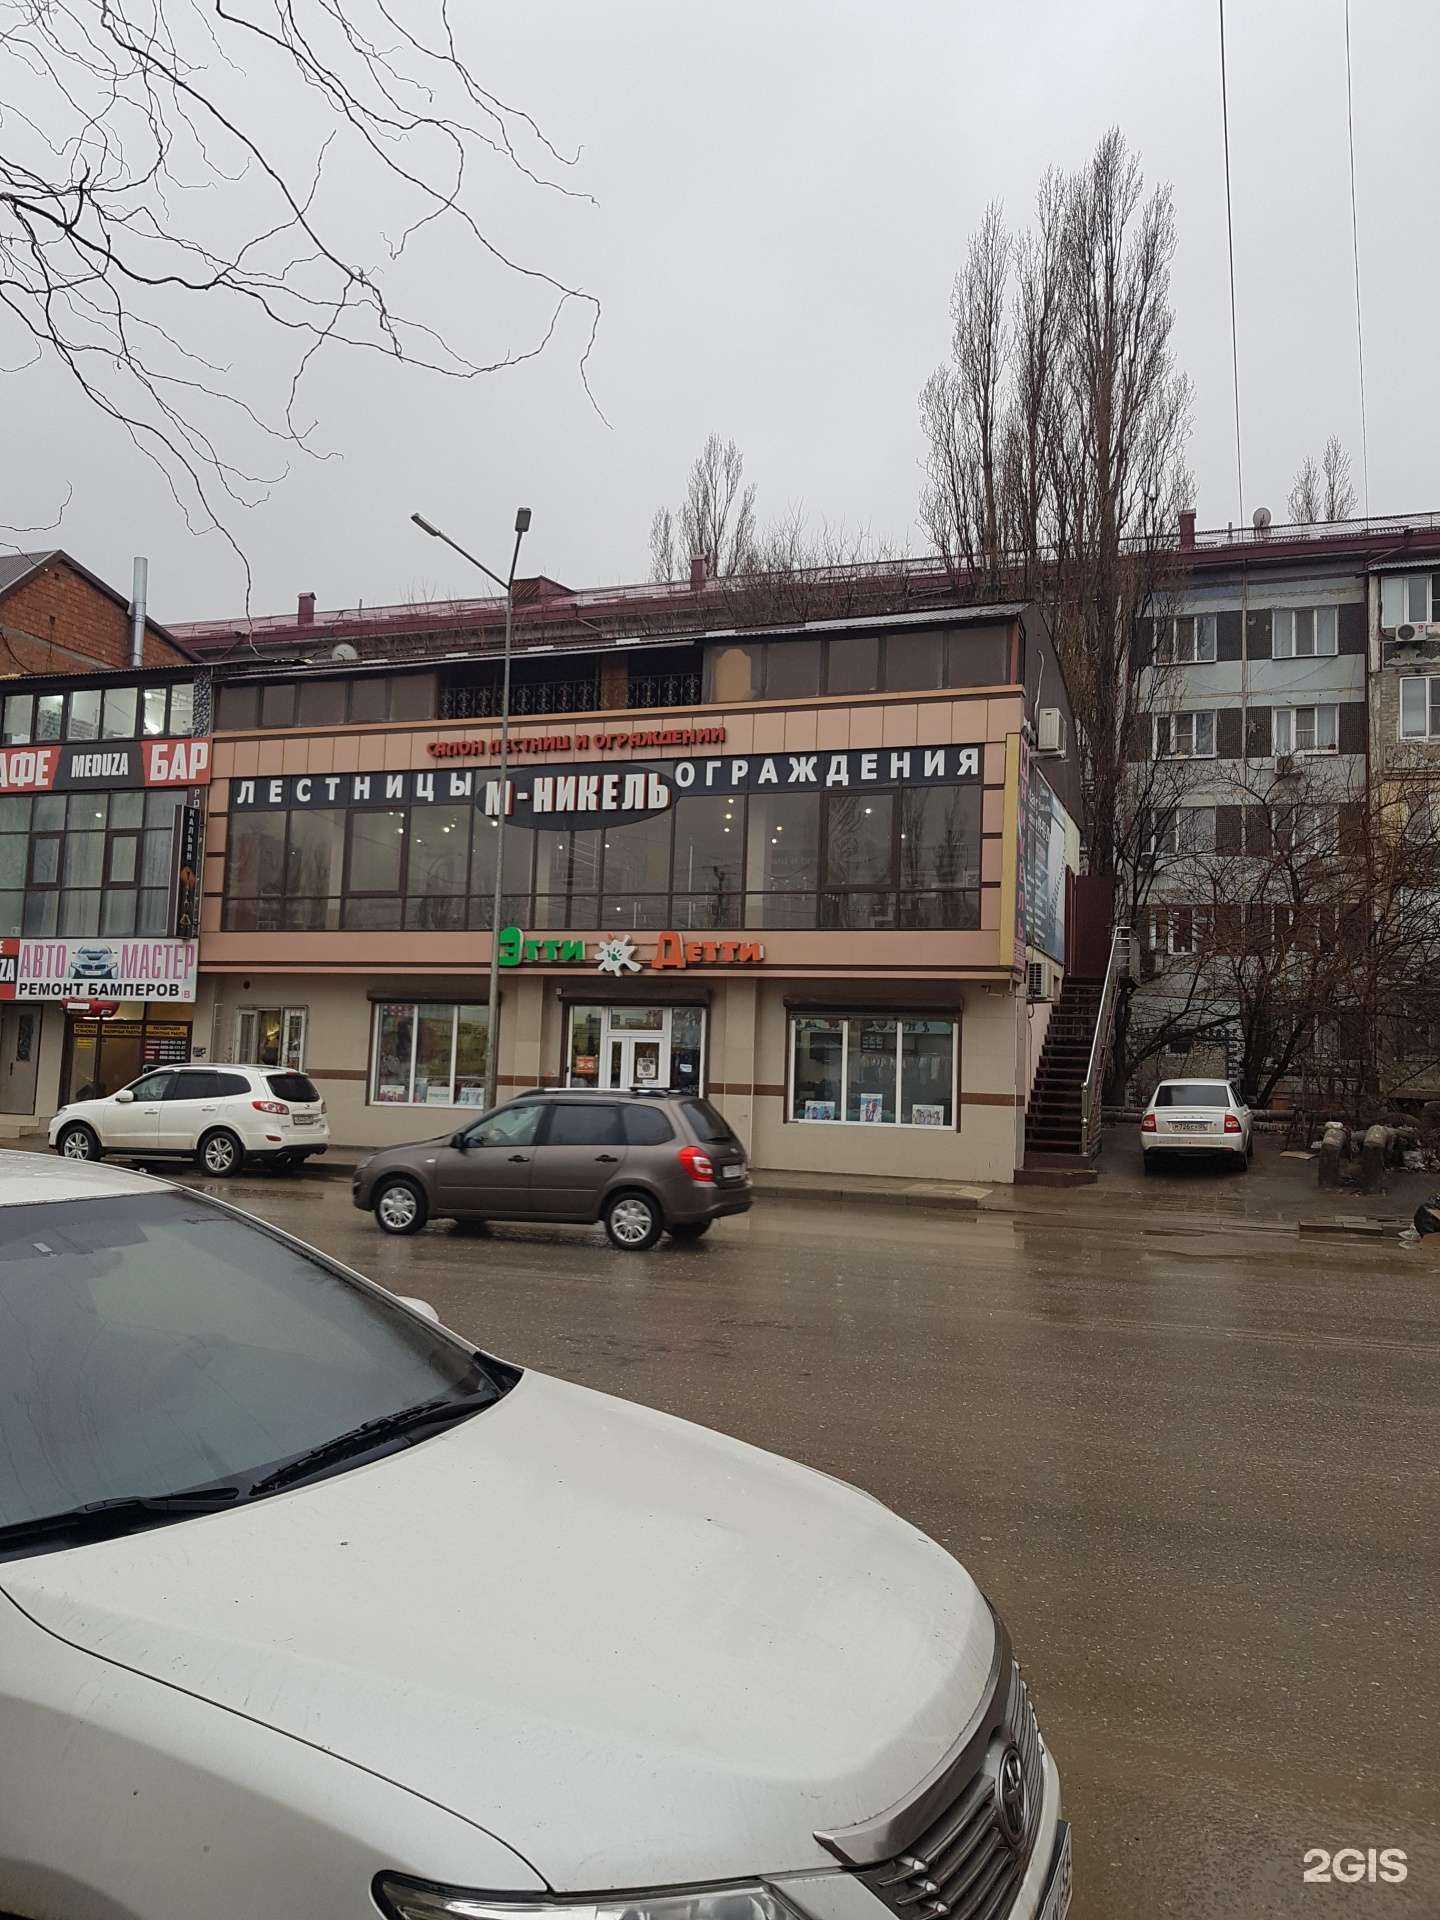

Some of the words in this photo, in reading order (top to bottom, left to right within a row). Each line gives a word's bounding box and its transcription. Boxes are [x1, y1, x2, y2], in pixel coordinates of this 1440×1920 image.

[150, 743, 209, 781] БАР
[427, 740, 484, 757] САЛОН
[575, 735, 589, 750] И
[71, 752, 129, 778] MEDUZA
[674, 748, 980, 788] ОГРАЖДЕНИЯ
[237, 772, 472, 804] ЛЕСТНИЦЫ
[186, 809, 196, 861] КАЛЬЯН
[20, 944, 67, 978] АВТО
[120, 944, 195, 980] МАСТЕР
[18, 983, 83, 996] РЕМОНТ
[88, 983, 179, 997] БАМПЕРОВ
